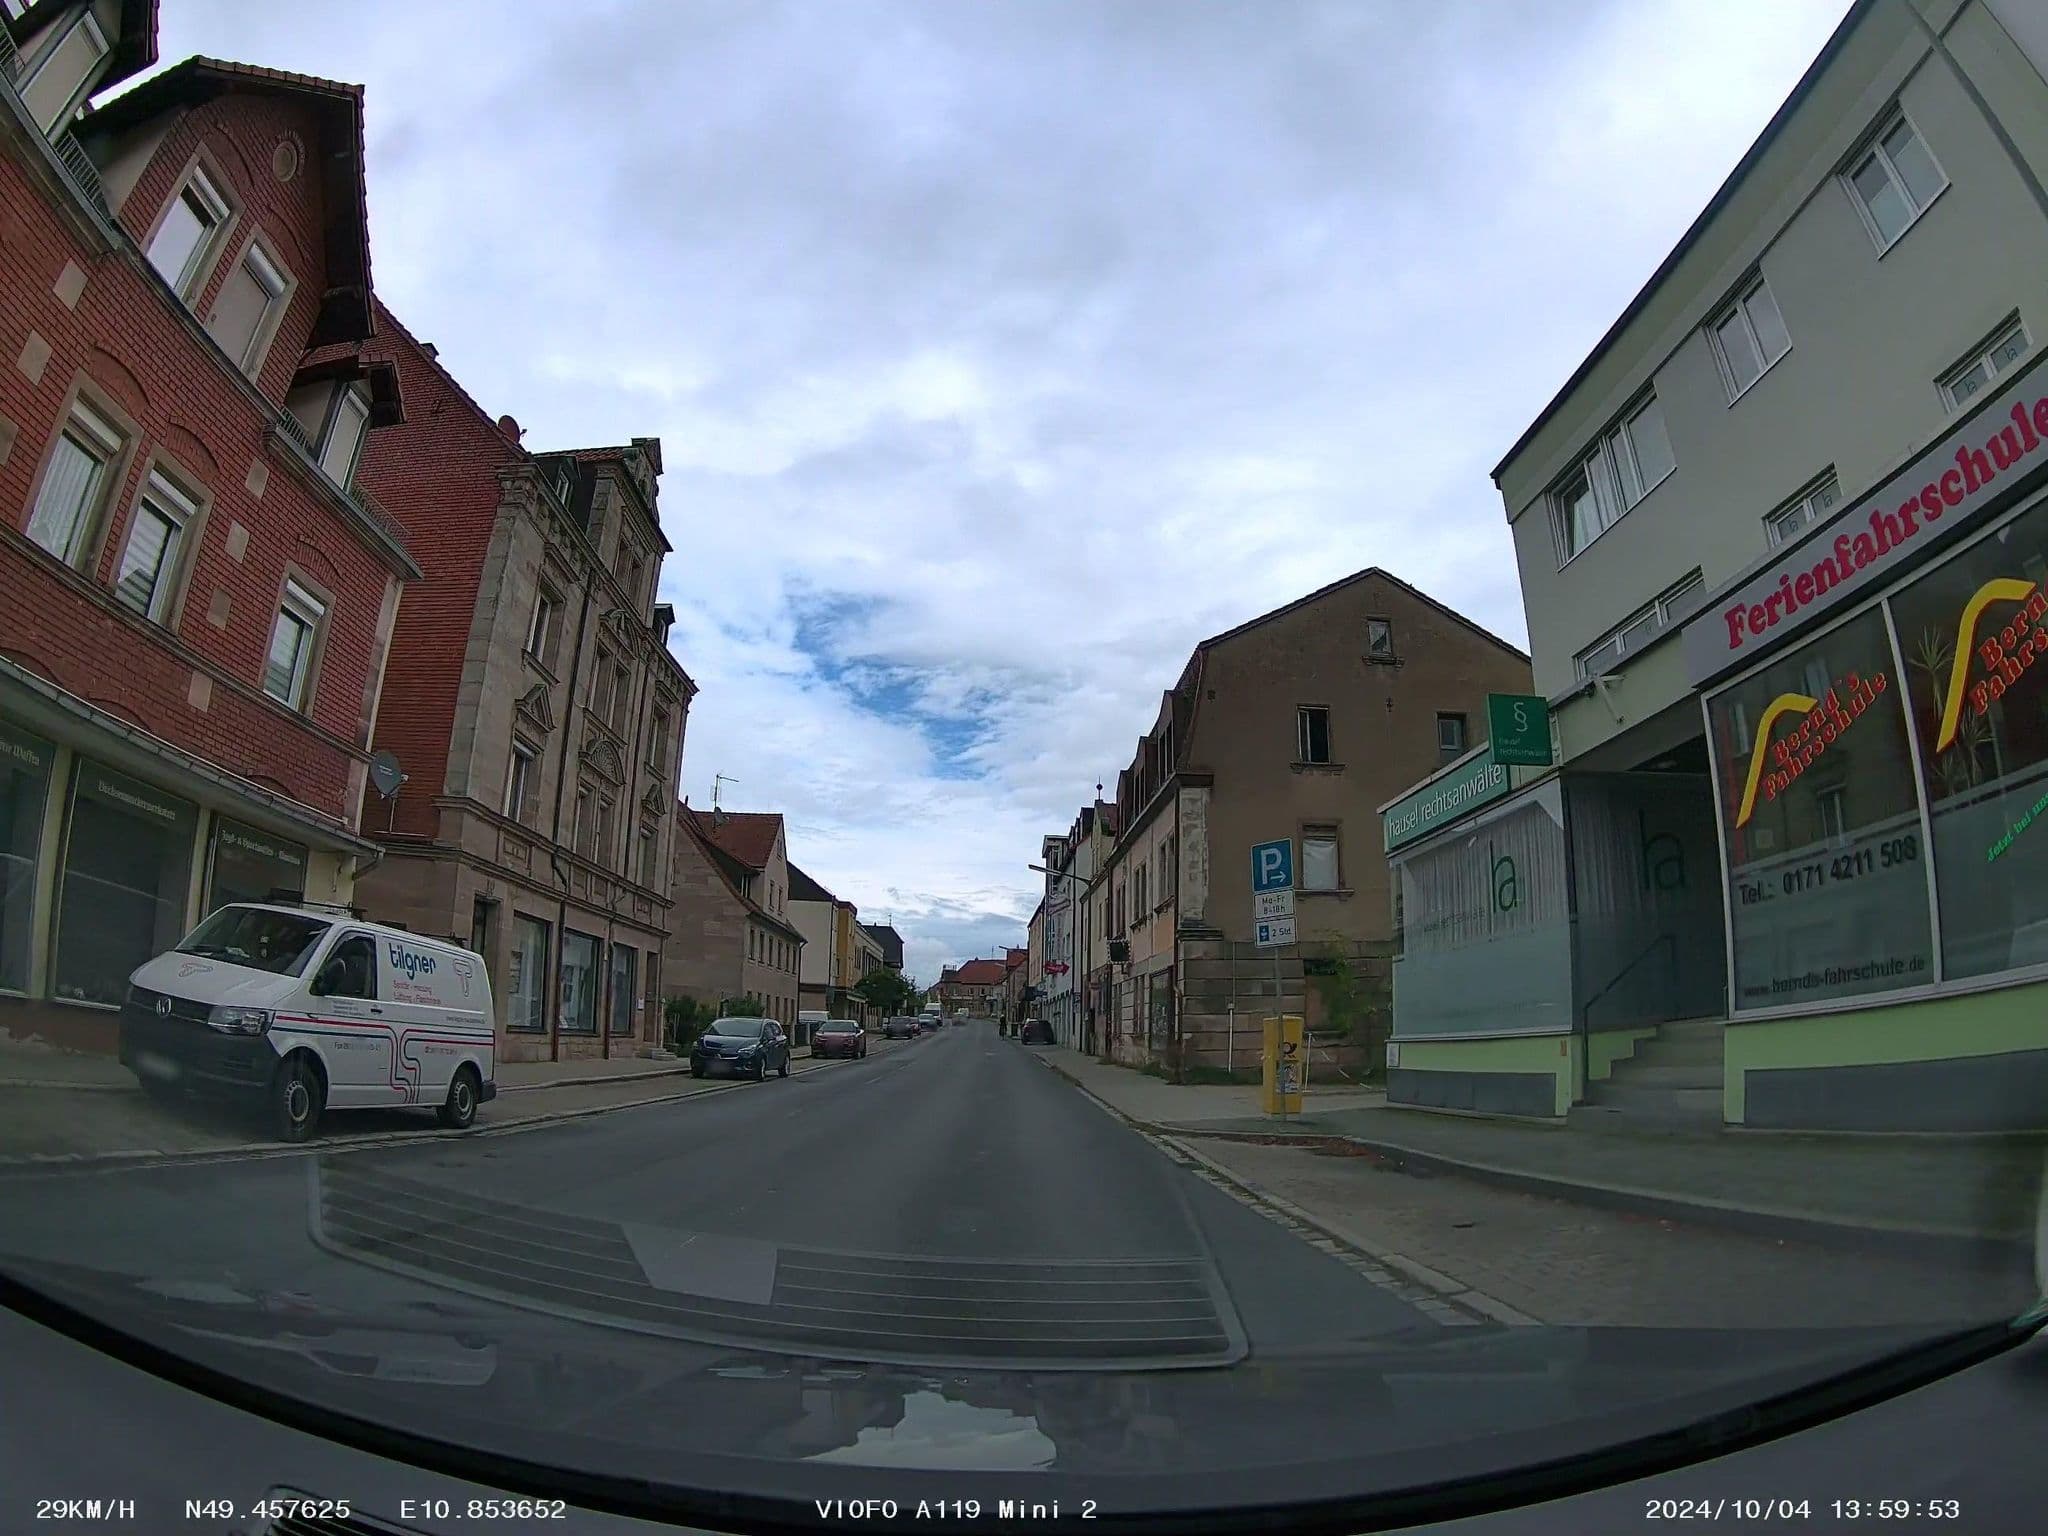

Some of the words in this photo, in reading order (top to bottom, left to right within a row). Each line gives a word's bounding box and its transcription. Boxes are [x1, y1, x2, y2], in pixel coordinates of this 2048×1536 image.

[1979, 576, 2048, 672] Bern
[1761, 672, 1888, 802] Fahrschule
[1389, 802, 1419, 839] hausel
[1421, 764, 1503, 823] rechtsanwälte
[1260, 847, 1282, 885] P
[1783, 863, 1824, 895] 0171
[1831, 848, 1873, 881] 4211
[388, 942, 437, 981] tilgner
